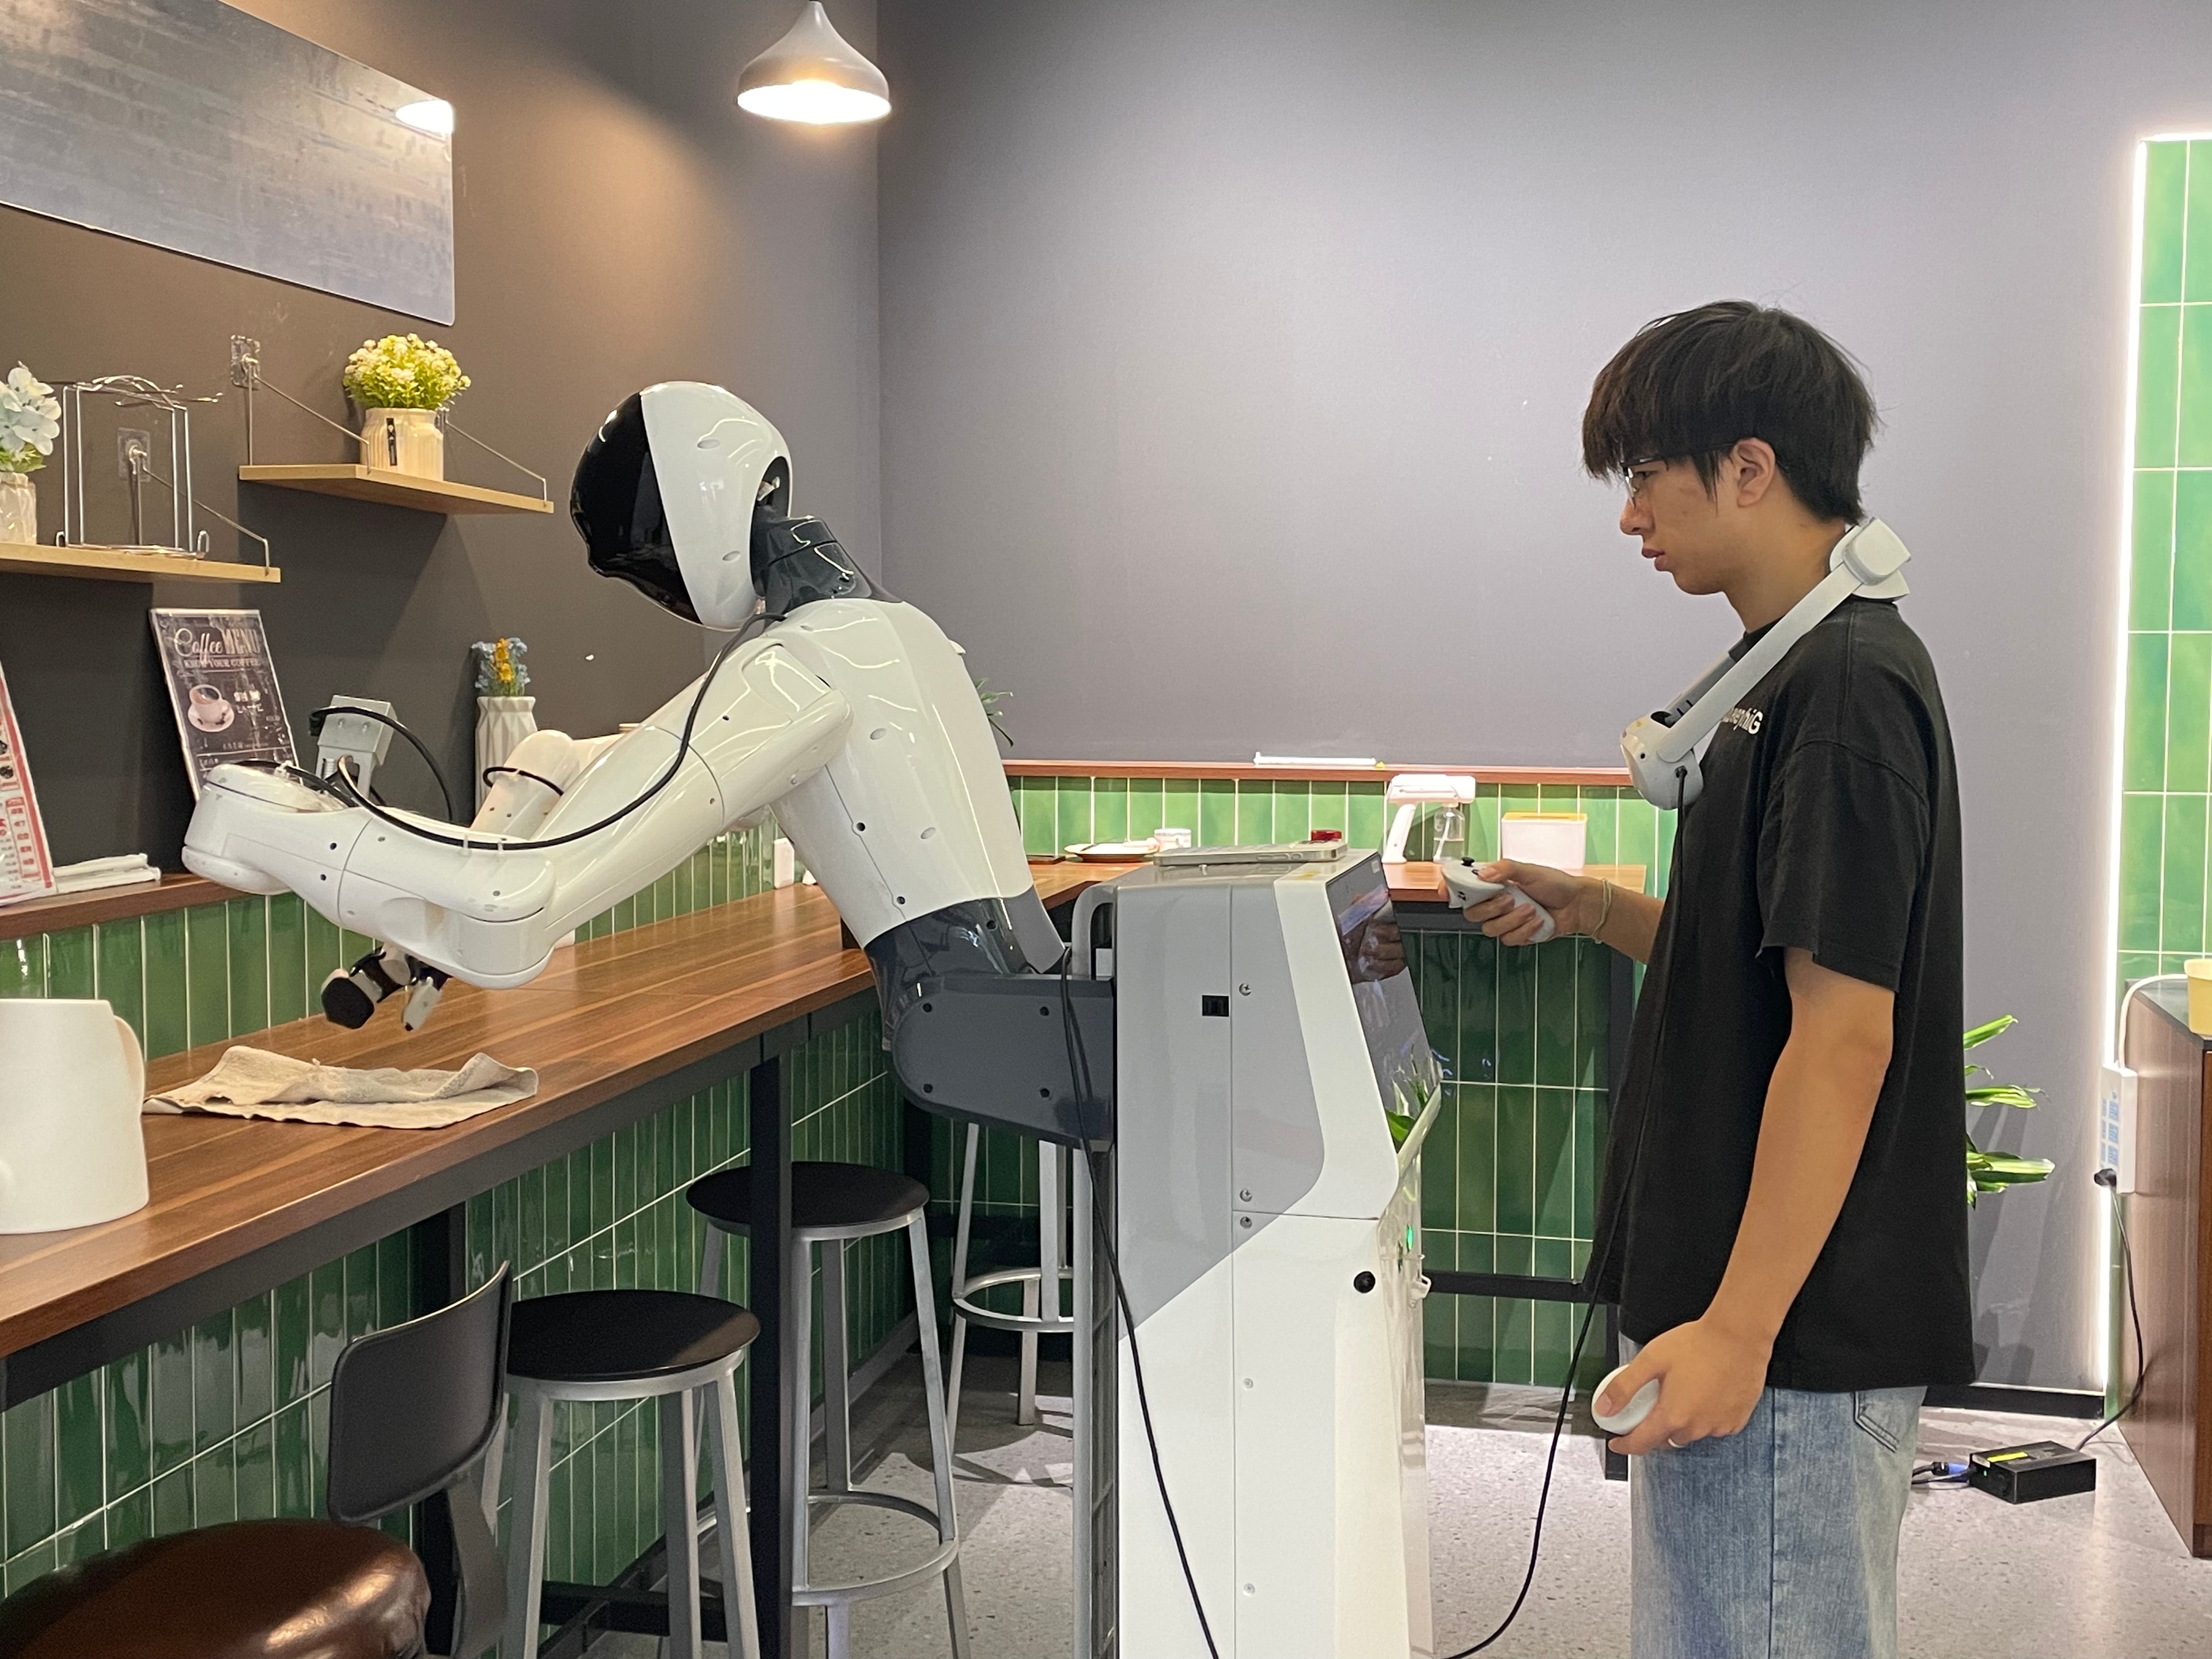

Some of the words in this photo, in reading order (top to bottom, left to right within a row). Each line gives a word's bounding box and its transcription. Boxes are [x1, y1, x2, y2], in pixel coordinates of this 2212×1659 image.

[174, 628, 224, 665] Coffee
[221, 628, 260, 654] MENU
[230, 658, 260, 667] COFFEE
